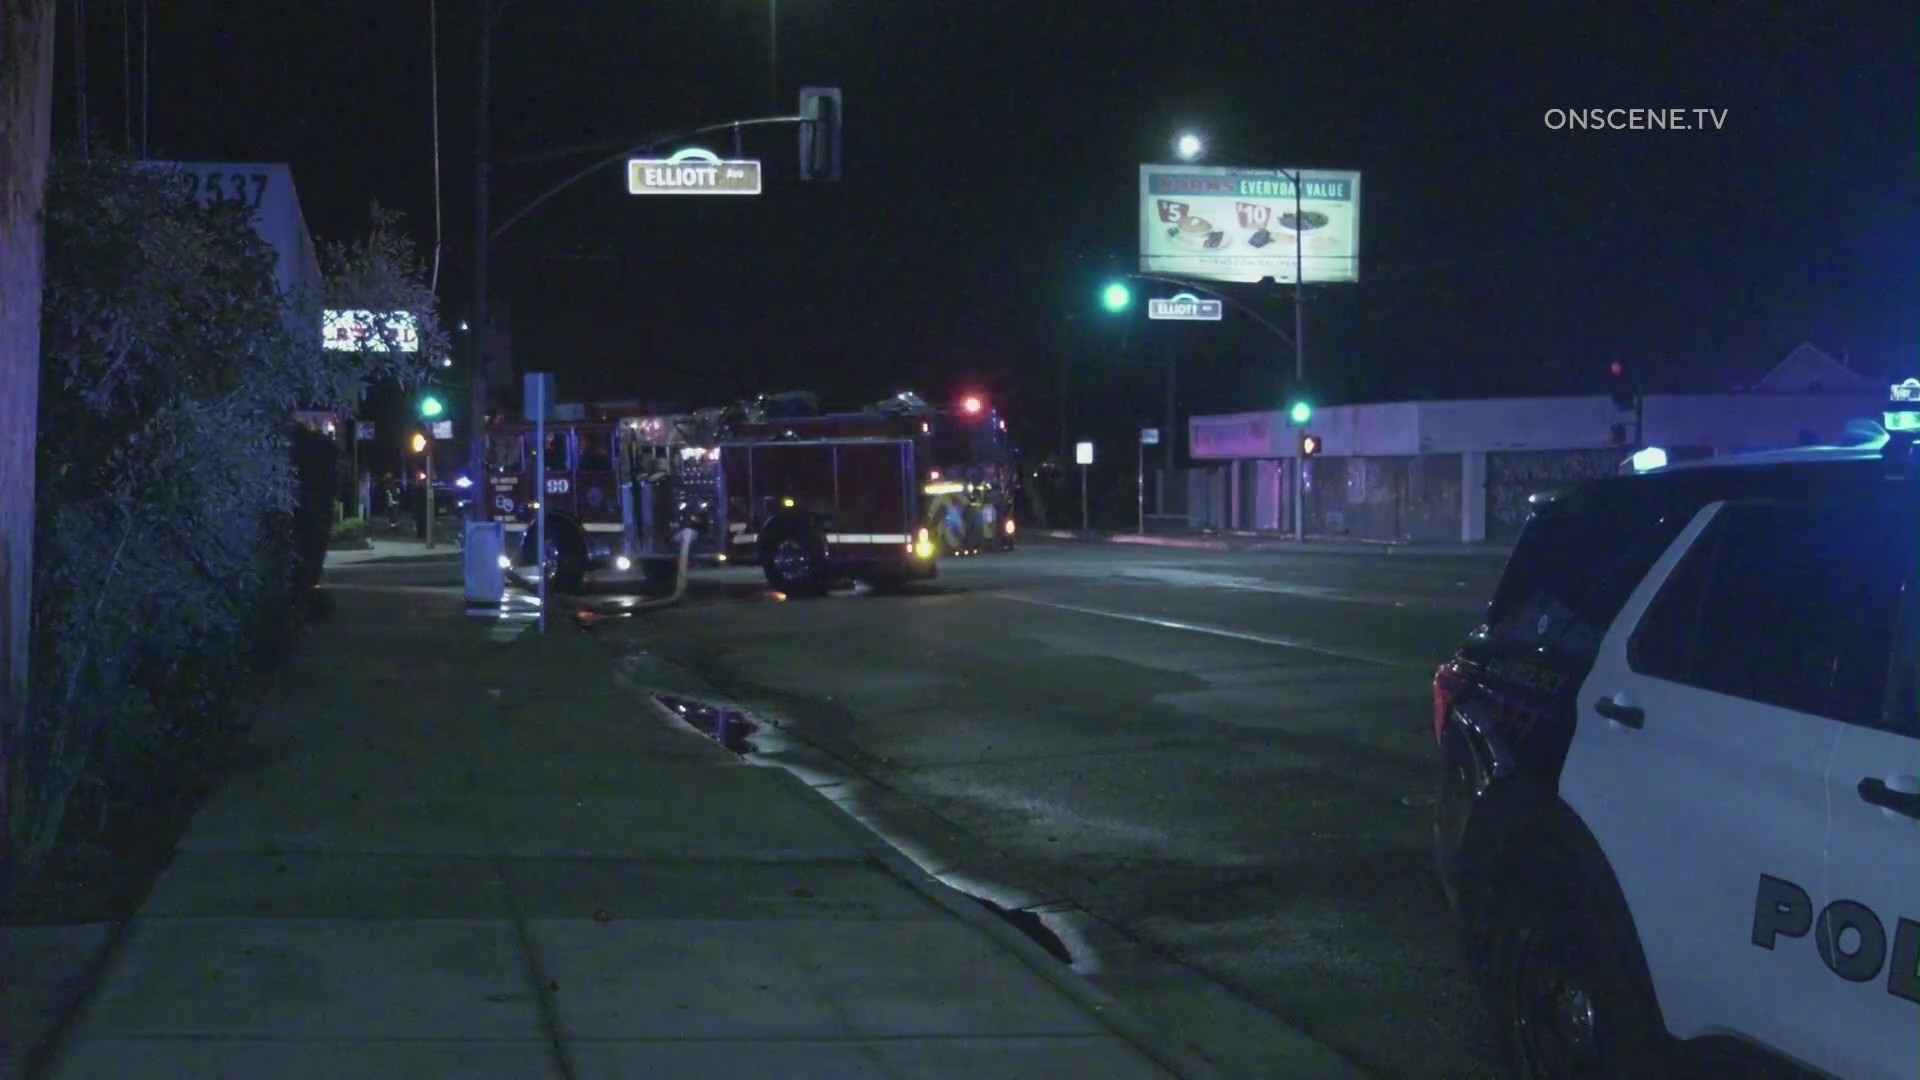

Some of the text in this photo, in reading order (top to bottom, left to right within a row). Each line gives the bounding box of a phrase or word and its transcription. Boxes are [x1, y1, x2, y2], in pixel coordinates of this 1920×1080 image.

[645, 167, 718, 186] ELLIOTT
[1306, 182, 1344, 197] VALUE
[1157, 303, 1198, 315] ELLIOTT
[547, 479, 569, 493] 90
